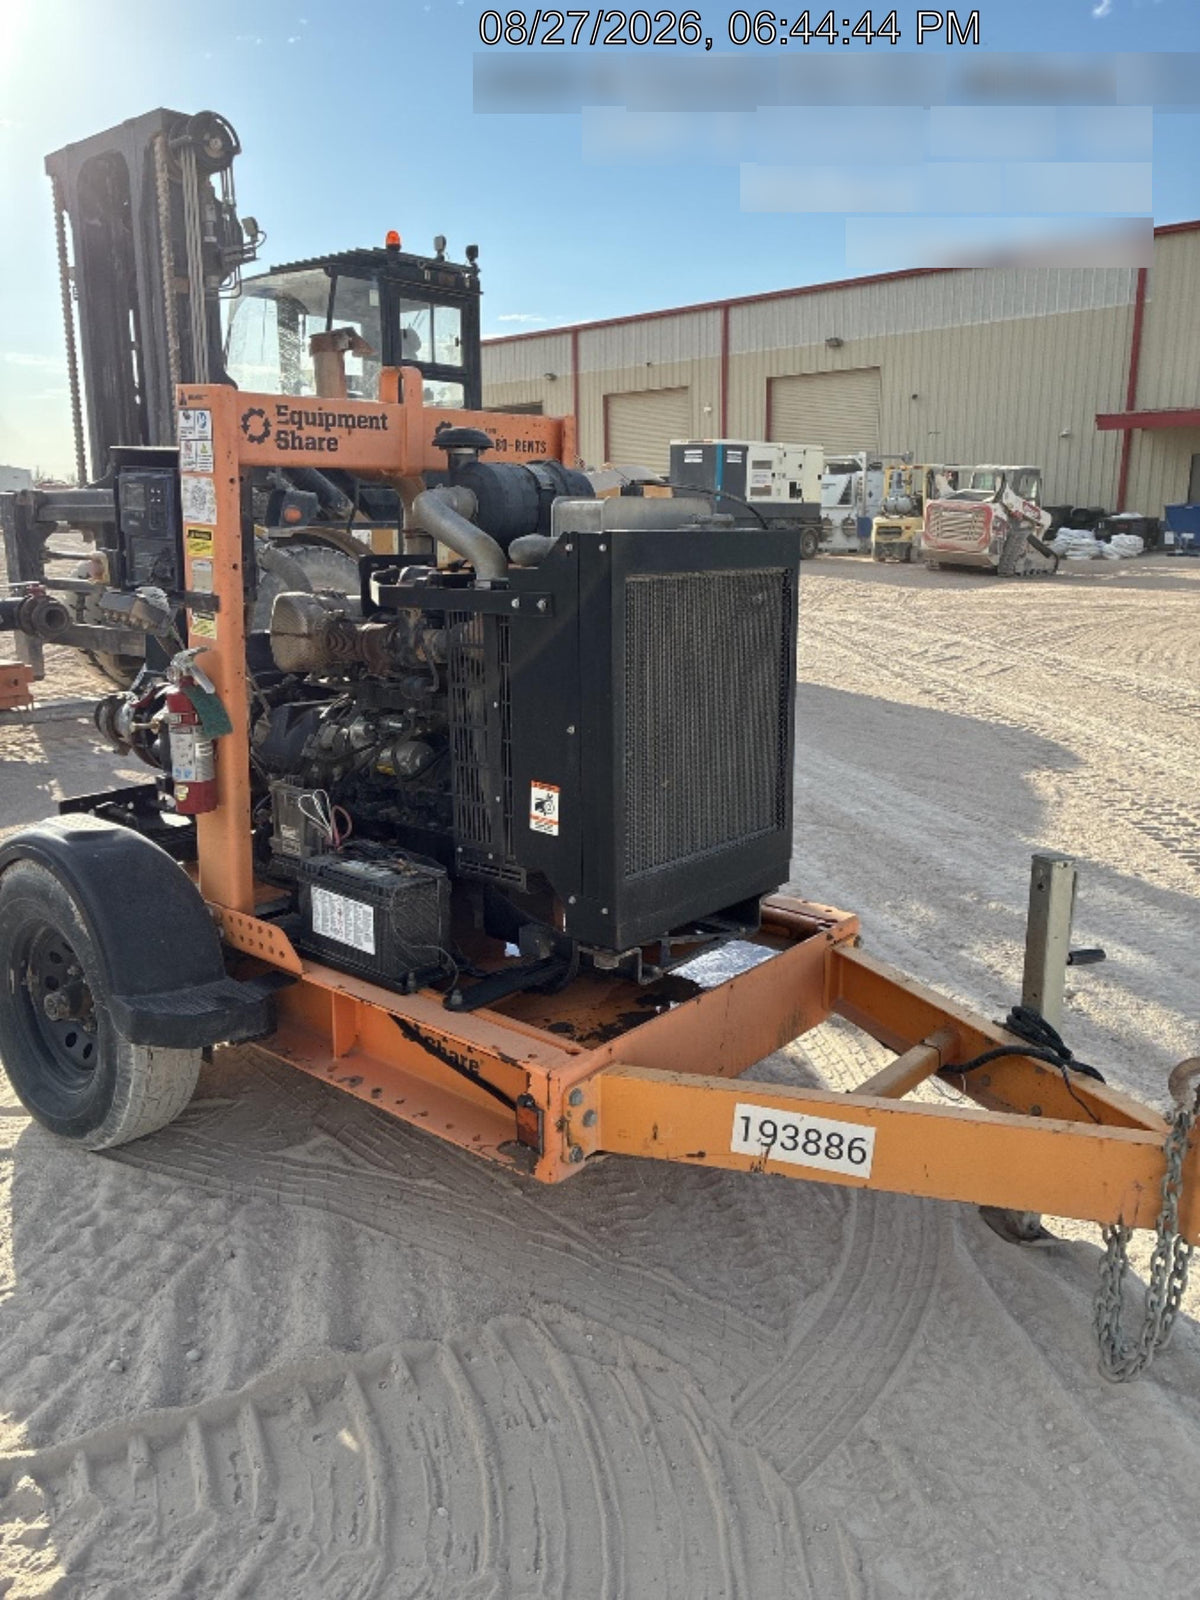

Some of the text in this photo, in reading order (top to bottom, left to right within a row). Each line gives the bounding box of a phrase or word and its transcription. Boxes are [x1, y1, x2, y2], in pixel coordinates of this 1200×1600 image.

[275, 404, 388, 432] Equipment
[275, 429, 338, 452] Share
[740, 1115, 867, 1165] 193886
